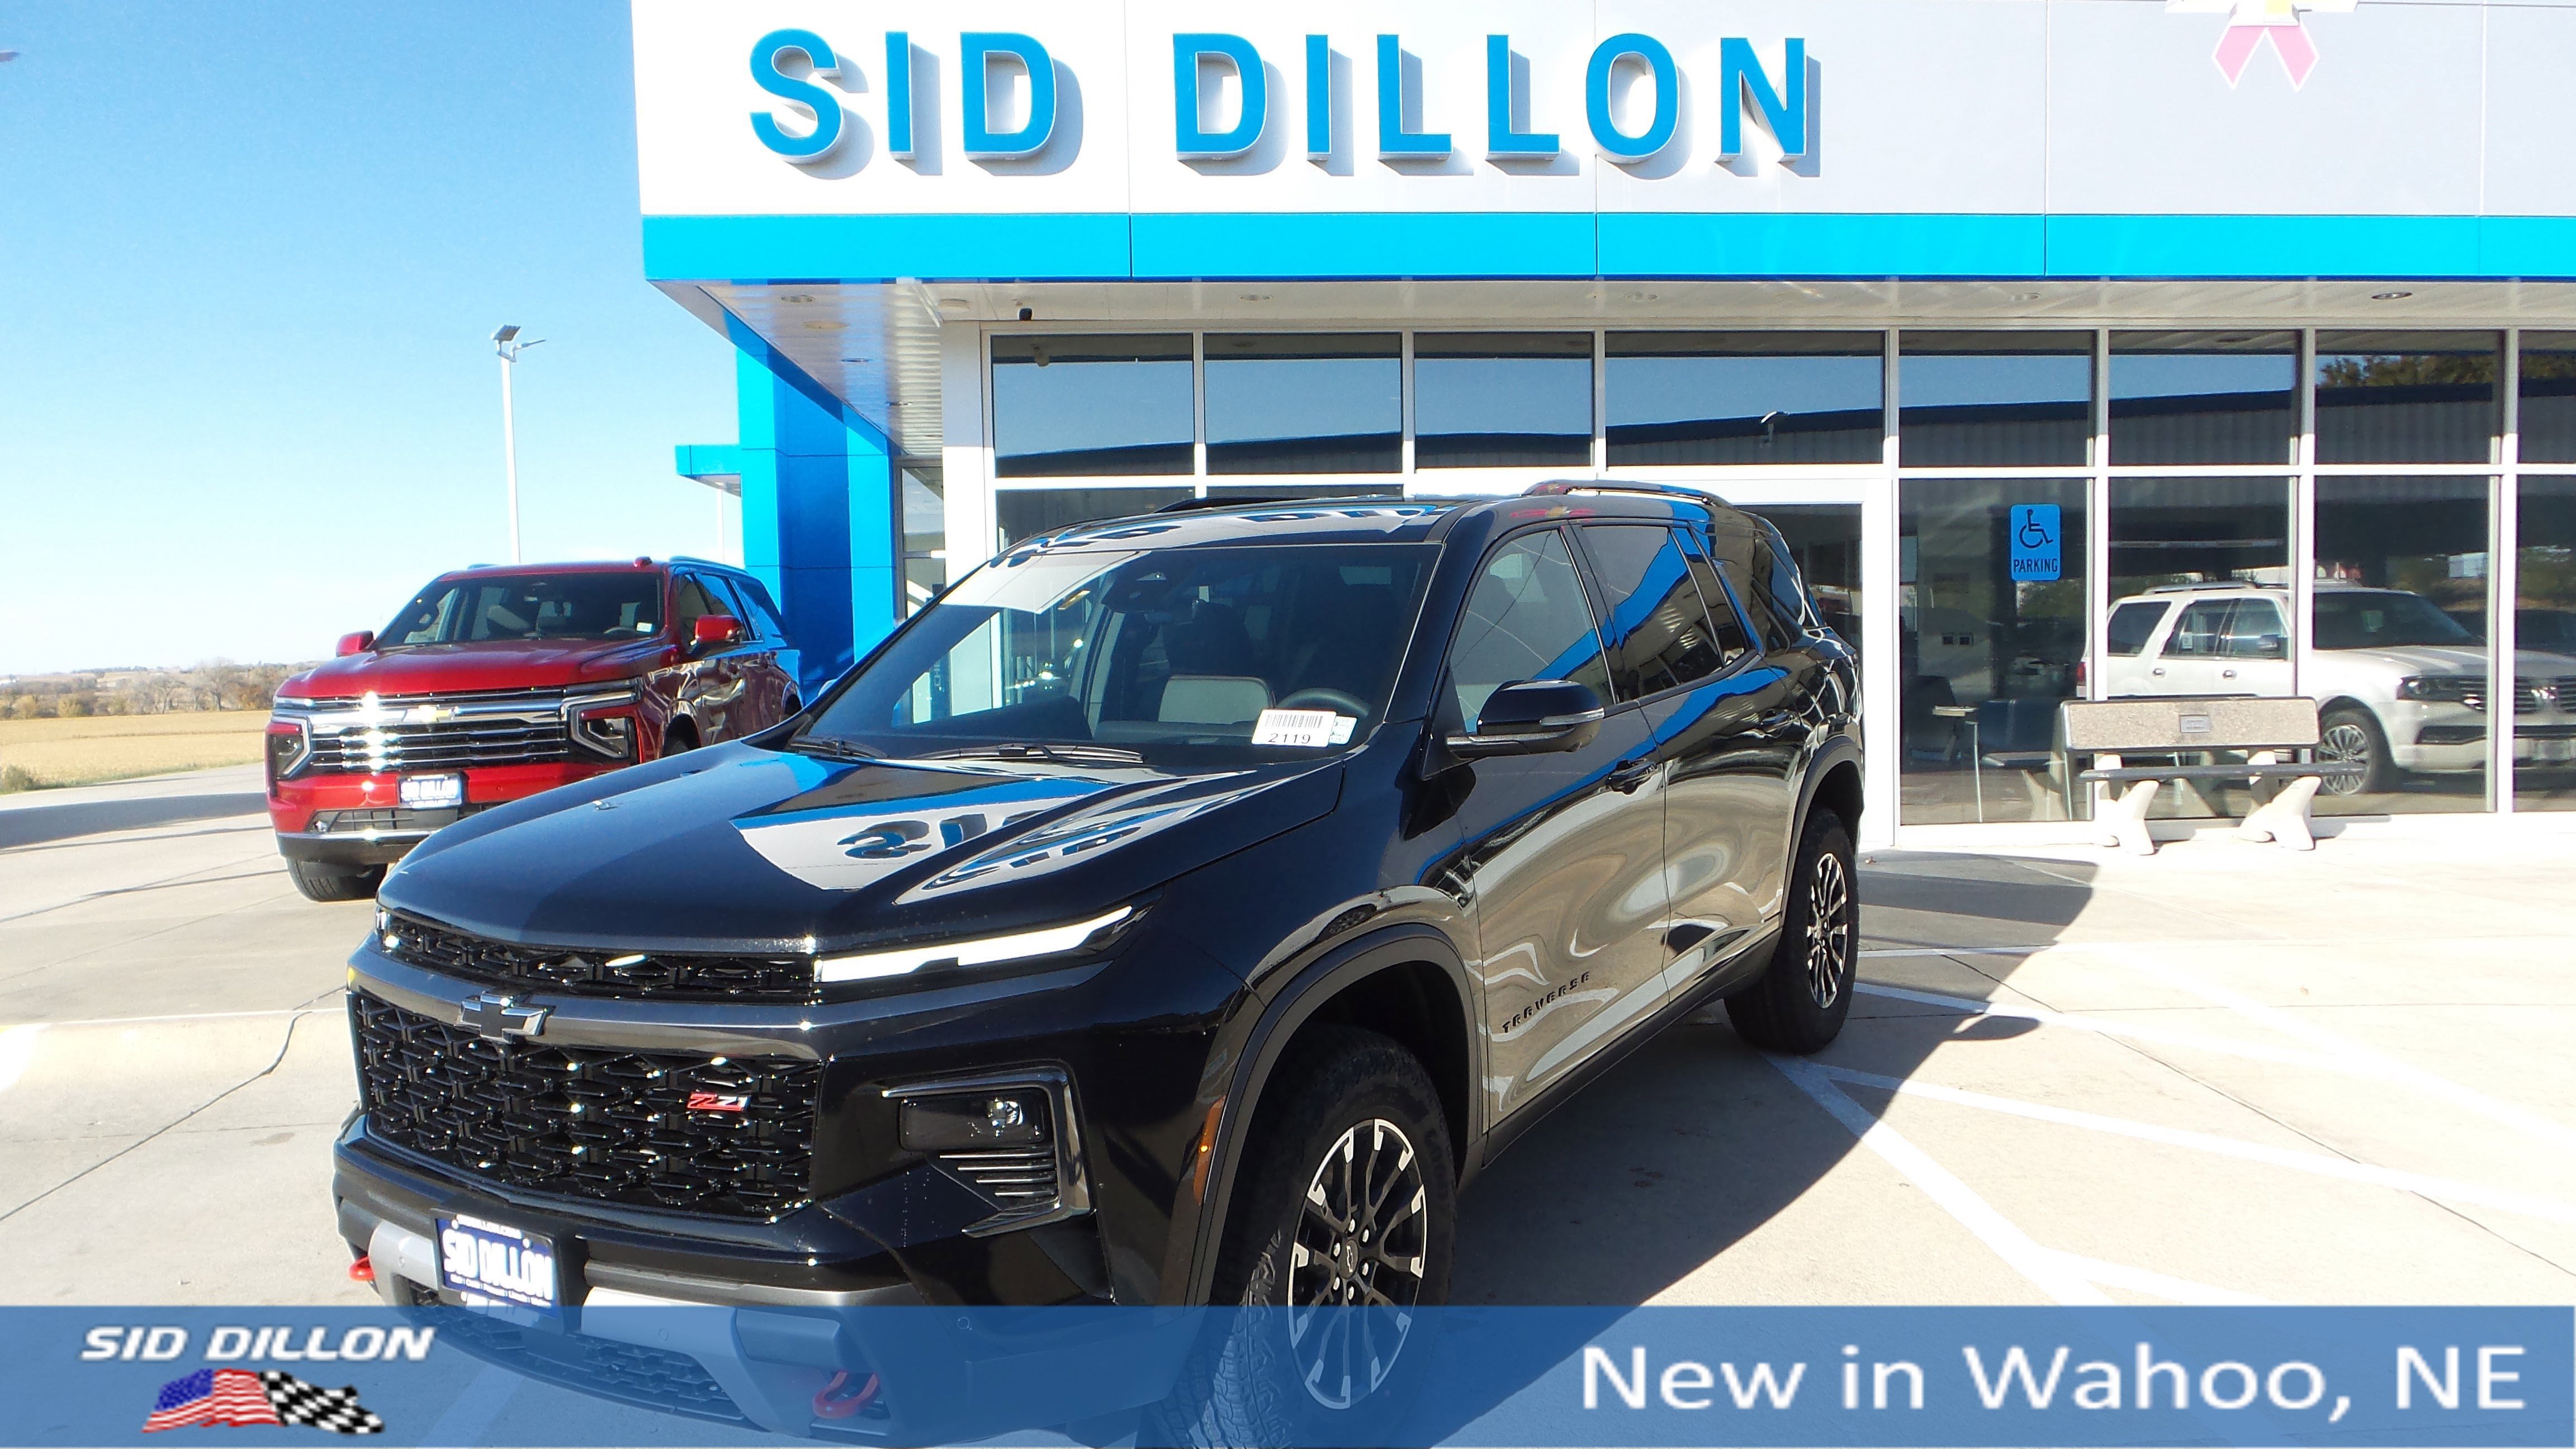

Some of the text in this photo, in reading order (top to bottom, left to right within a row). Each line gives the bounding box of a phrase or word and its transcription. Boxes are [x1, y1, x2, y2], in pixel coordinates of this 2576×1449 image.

[749, 29, 1807, 163] SID DILLON
[2013, 558, 2058, 573] PARKING
[1268, 733, 1311, 745] 2119
[1502, 971, 1590, 1033] TRAVERSE
[442, 1229, 478, 1278] SID
[478, 1238, 553, 1300] DILLON
